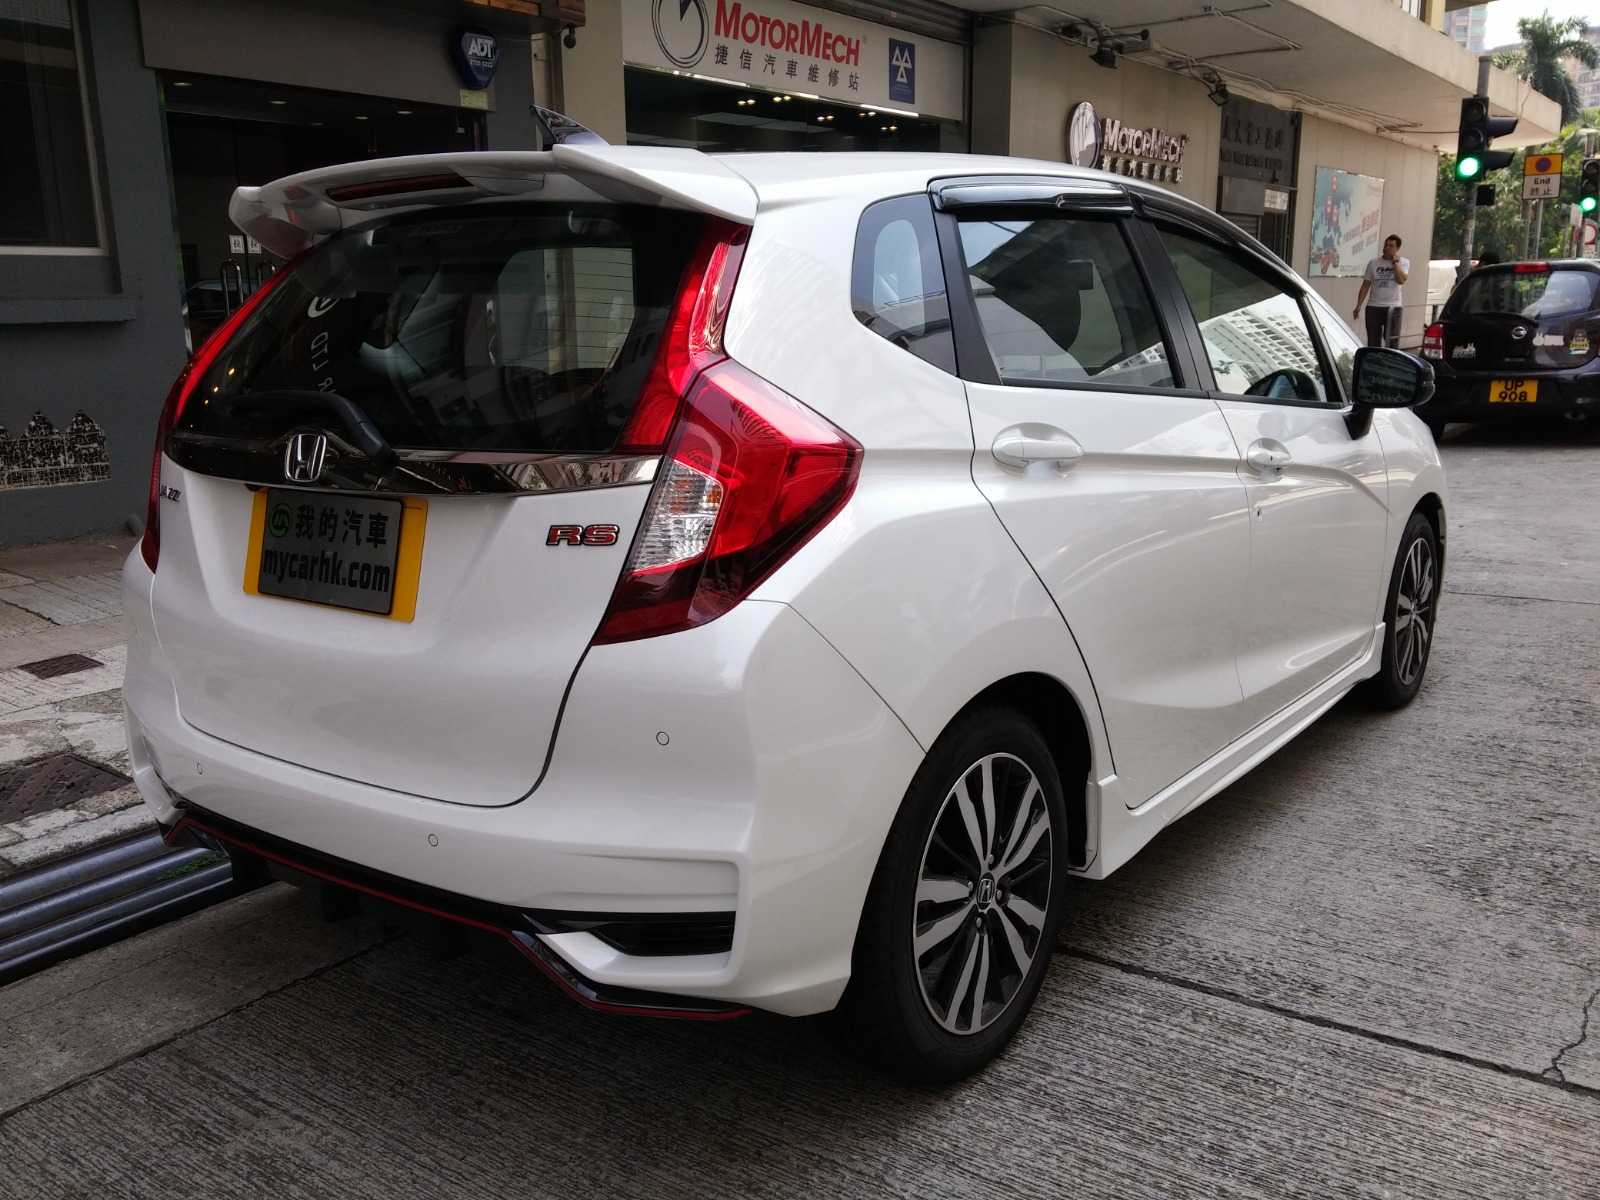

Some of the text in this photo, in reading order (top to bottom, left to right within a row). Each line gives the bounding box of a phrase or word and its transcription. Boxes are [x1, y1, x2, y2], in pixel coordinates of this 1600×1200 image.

[469, 37, 493, 58] ADT
[714, 42, 860, 92] 捷信汽車維修站
[1534, 177, 1551, 185] End
[1530, 186, 1553, 196] 終止
[1504, 380, 1524, 390] UP
[1499, 390, 1528, 402] 908
[159, 485, 183, 503] JAZZ
[295, 504, 390, 548] 我的汽車
[545, 524, 620, 547] RS
[262, 547, 391, 593] mycarhk.com
